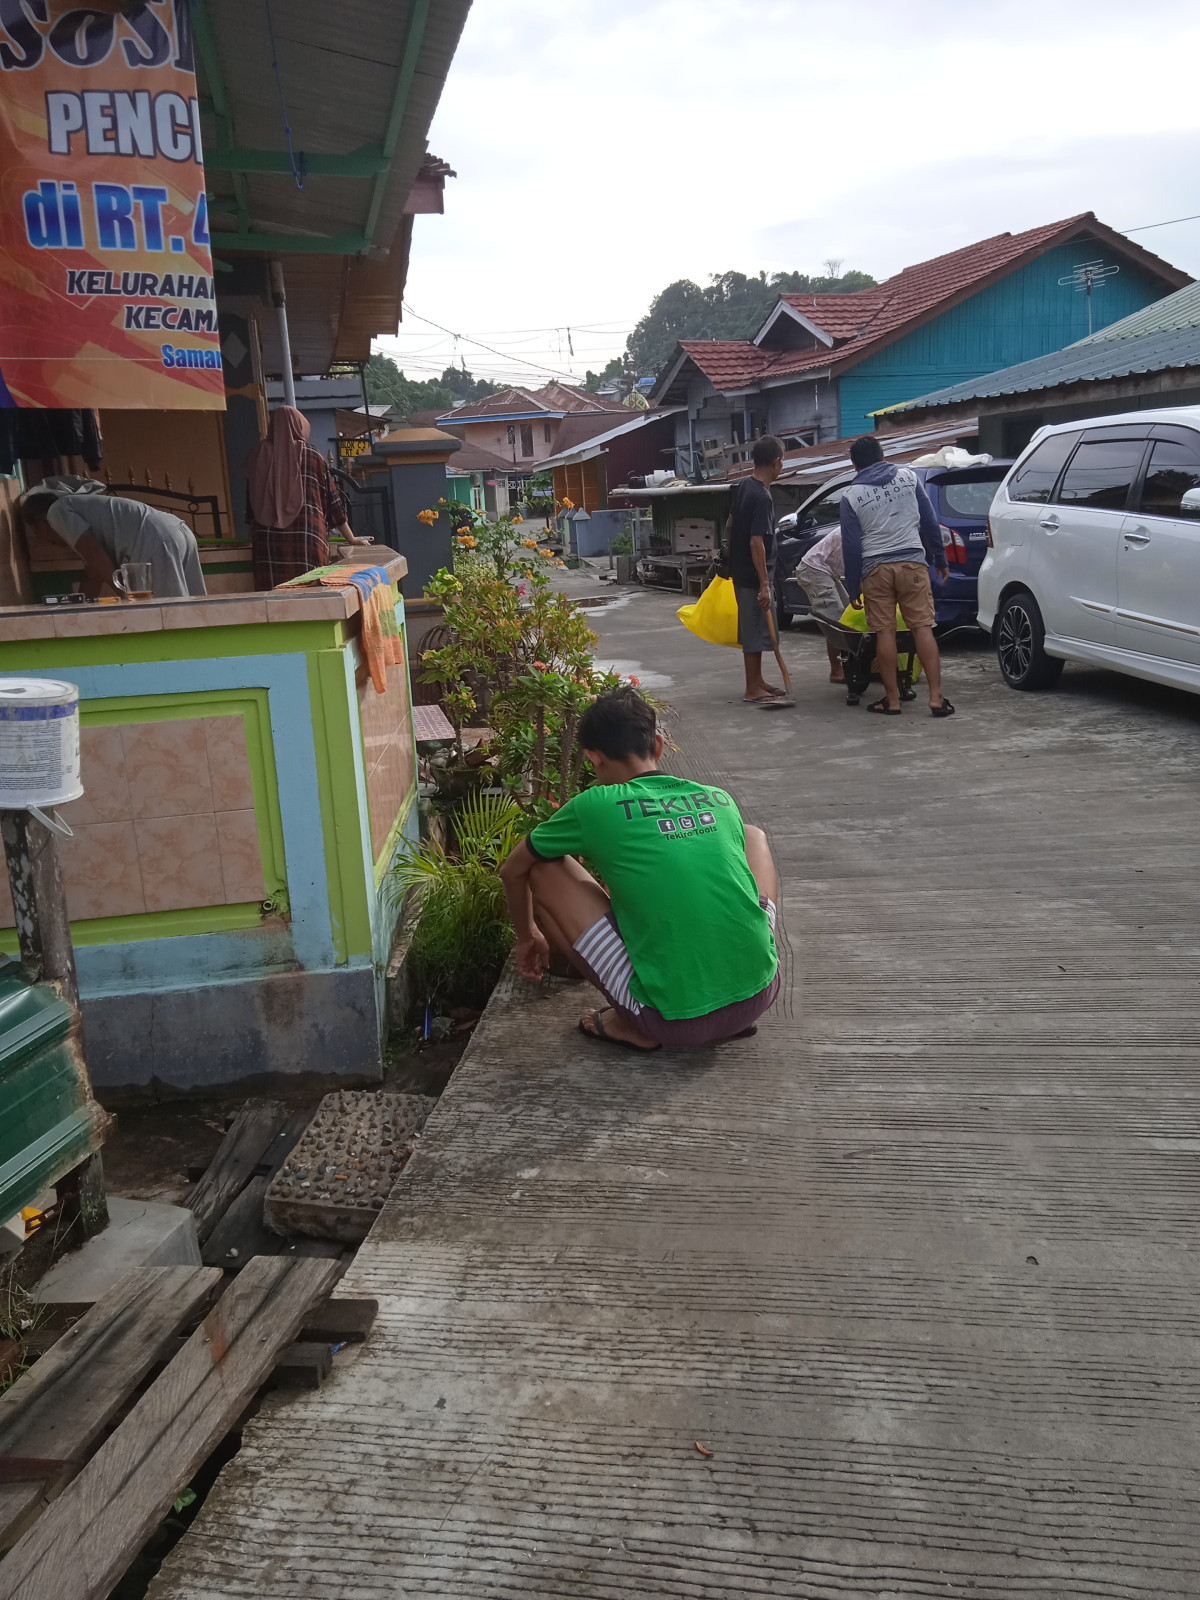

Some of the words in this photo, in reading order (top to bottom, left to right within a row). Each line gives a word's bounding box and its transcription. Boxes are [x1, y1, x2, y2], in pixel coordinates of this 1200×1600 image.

[23, 180, 85, 250] di
[92, 182, 186, 254] RT.
[875, 486, 901, 502] PRO
[616, 790, 730, 821] TEKIRO
[664, 830, 693, 841] Tekiro
[692, 825, 718, 836] Tools
